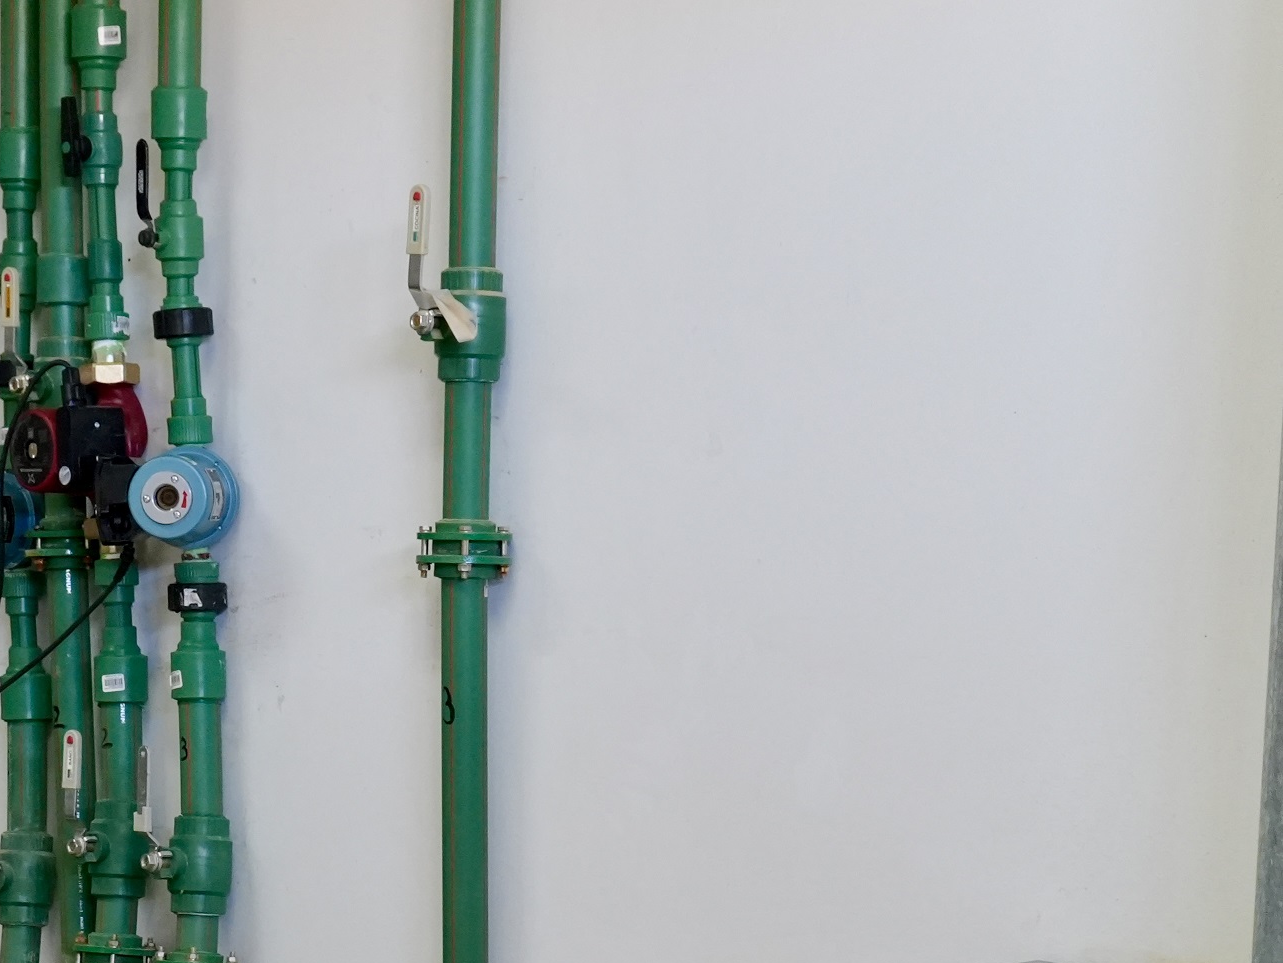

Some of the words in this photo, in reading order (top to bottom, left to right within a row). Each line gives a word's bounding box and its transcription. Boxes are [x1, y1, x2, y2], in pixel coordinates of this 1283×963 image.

[53, 705, 66, 729] 2
[442, 686, 456, 725] 3
[101, 728, 114, 749] 2
[180, 735, 189, 762] 3
